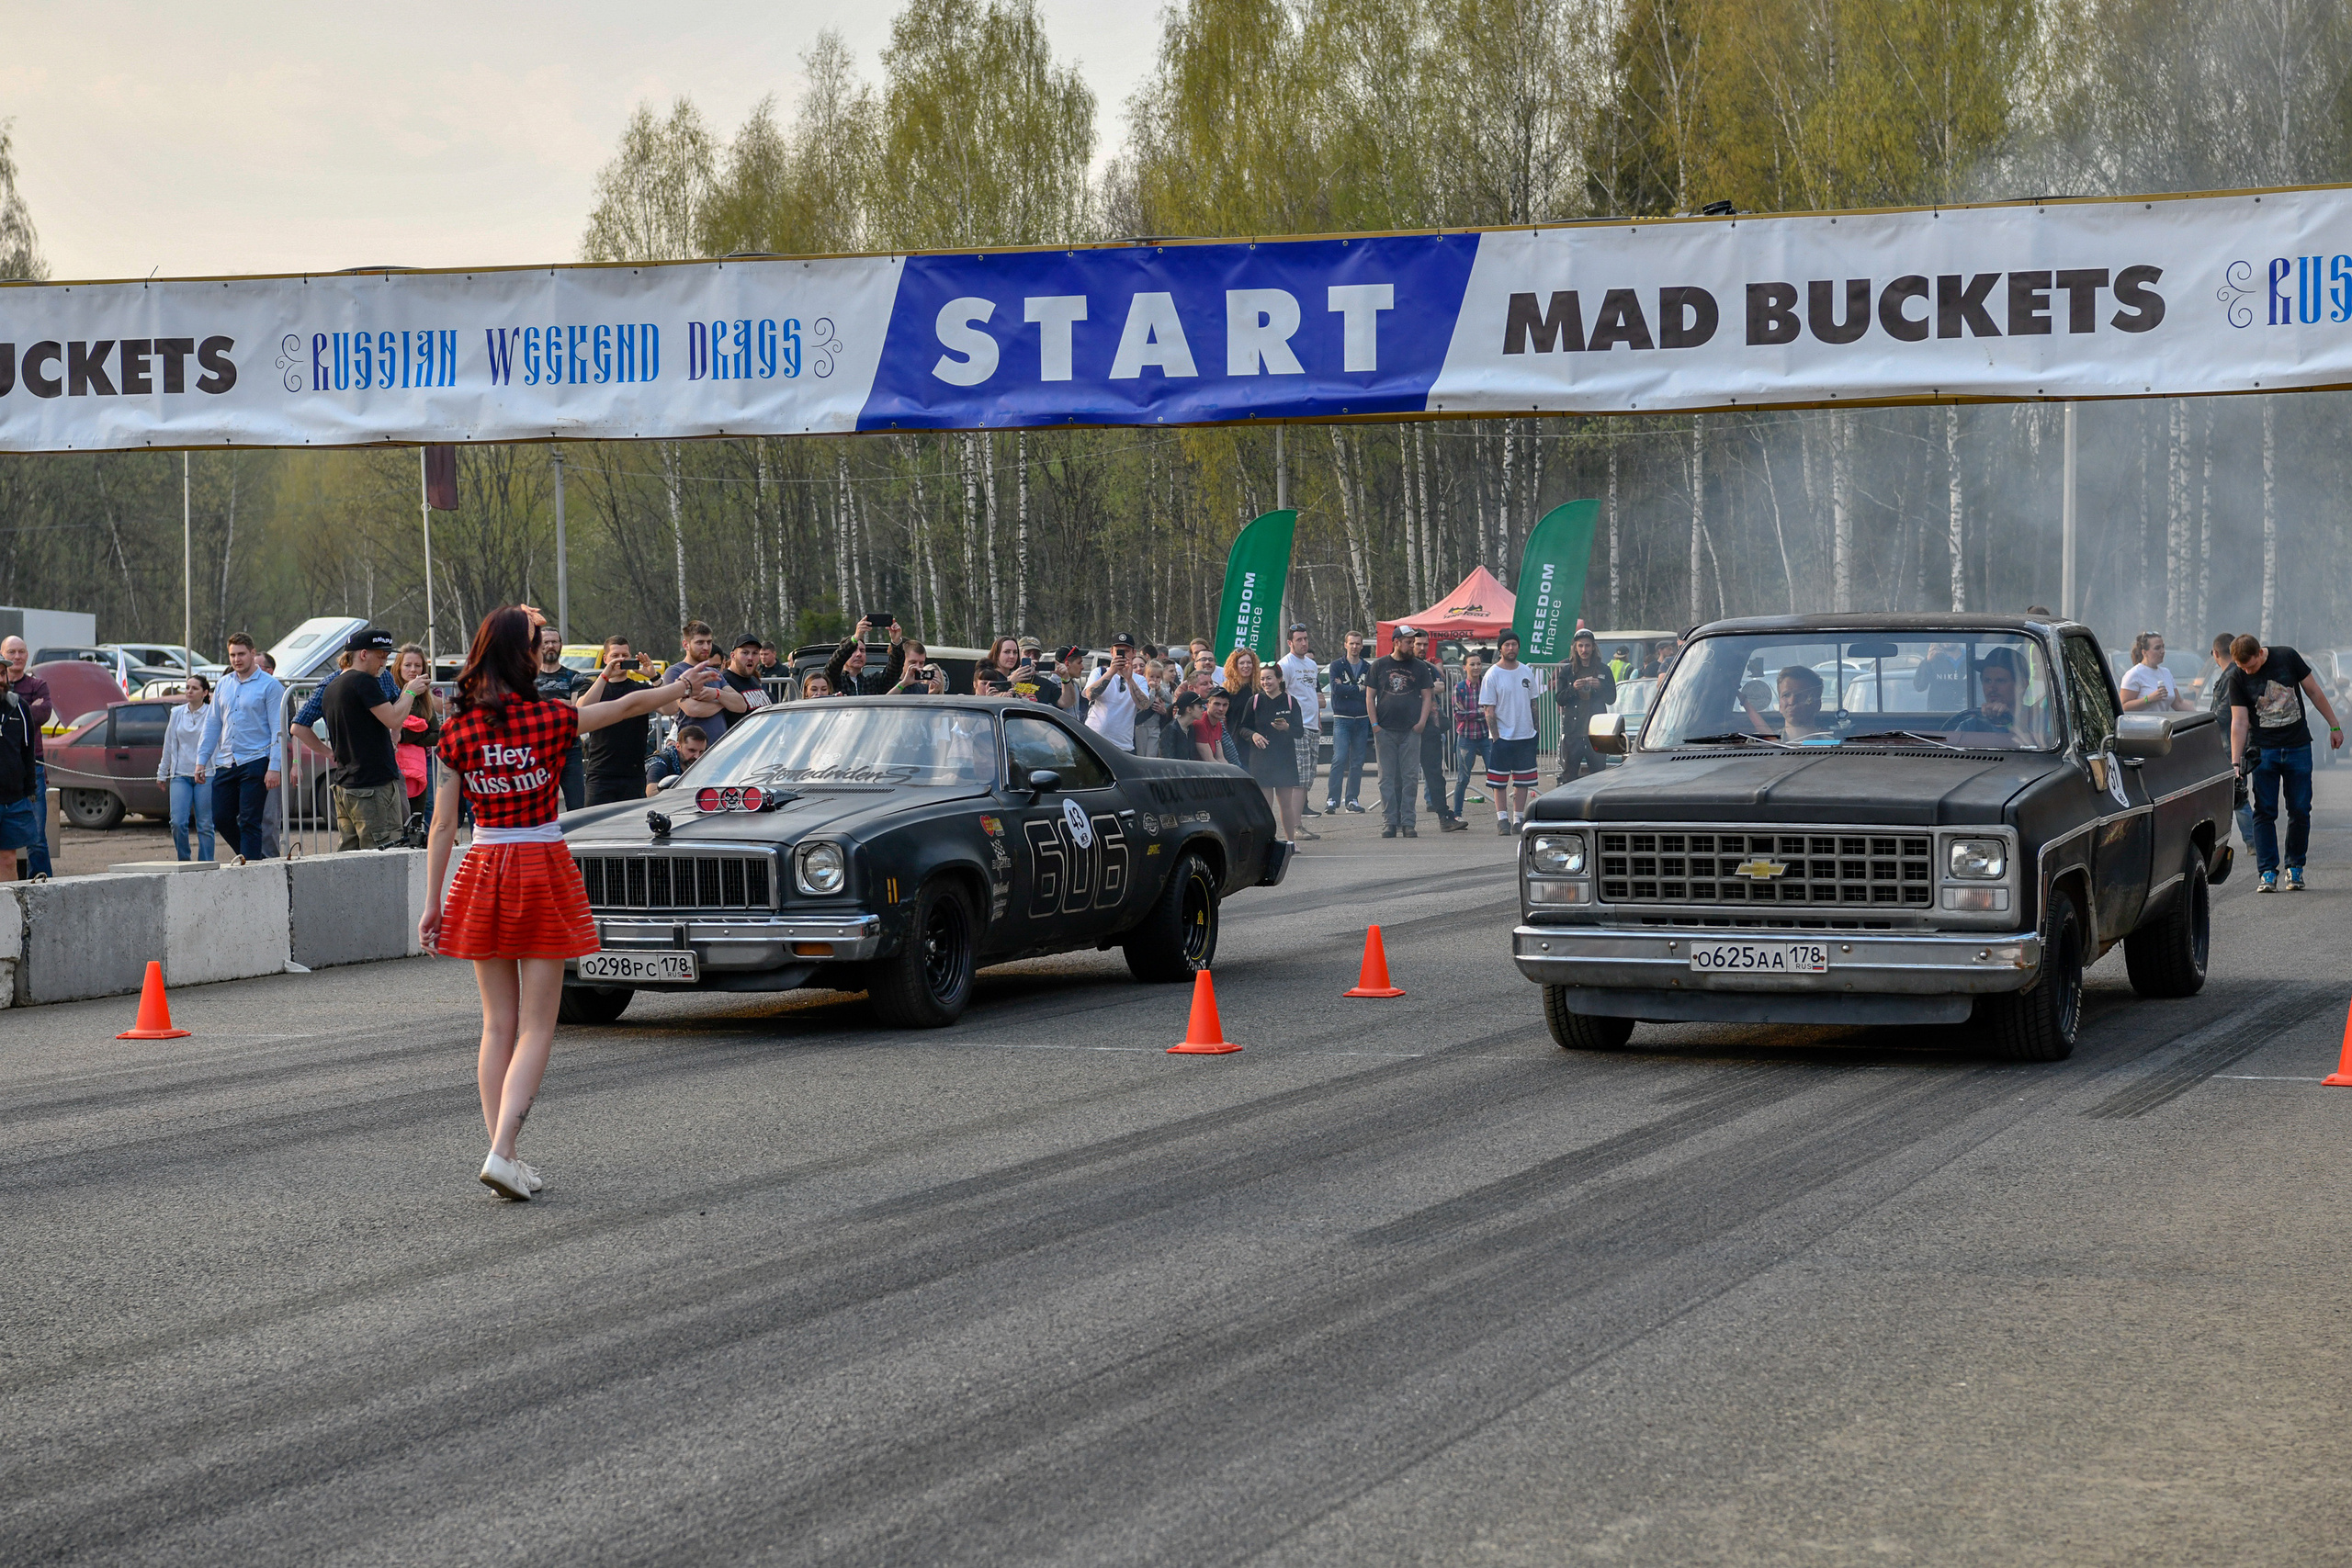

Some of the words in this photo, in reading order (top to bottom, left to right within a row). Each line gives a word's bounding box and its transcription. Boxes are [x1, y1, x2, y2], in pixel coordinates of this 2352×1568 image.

[931, 283, 1395, 387] START
[1502, 286, 1719, 355] MAD
[1746, 264, 2165, 346] BUCKETS
[0, 335, 237, 399] CKETS
[312, 328, 457, 391] RUSSIAN
[485, 322, 660, 387] WEEKEND
[687, 318, 802, 381] DRAGS
[1235, 571, 1256, 649] REEDOM
[1530, 563, 1555, 655] FREEDOM
[1542, 600, 1562, 656] finance
[1936, 672, 1959, 681] NIKE
[464, 770, 511, 795] Kiss
[512, 767, 551, 792] me.
[481, 744, 537, 770] Hey,
[2109, 762, 2120, 791] 31
[1069, 807, 1084, 831] 43
[1024, 814, 1129, 919] 606
[661, 957, 688, 972] 178
[1790, 946, 1821, 963] 178
